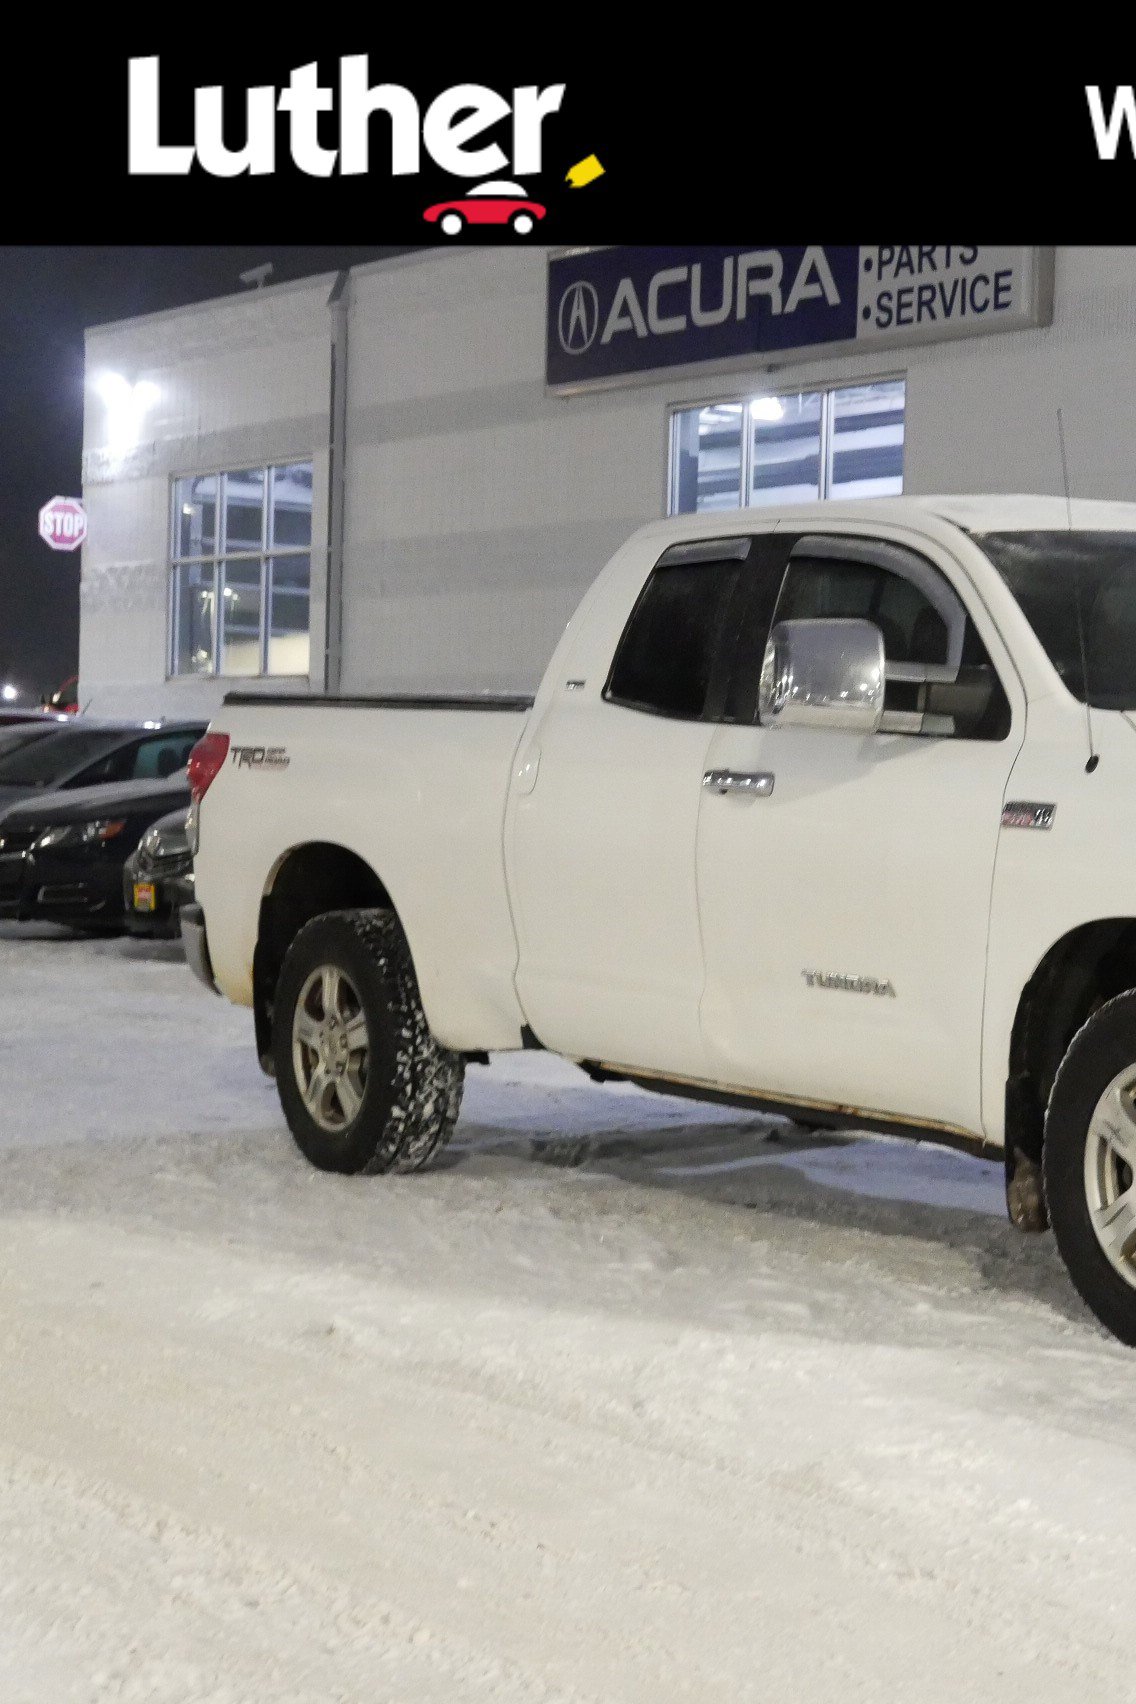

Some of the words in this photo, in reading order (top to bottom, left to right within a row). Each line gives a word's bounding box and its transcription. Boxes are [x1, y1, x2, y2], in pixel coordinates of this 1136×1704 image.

[600, 245, 841, 345] ACURA
[875, 269, 1013, 329] SERVICE
[44, 511, 84, 537] STOP
